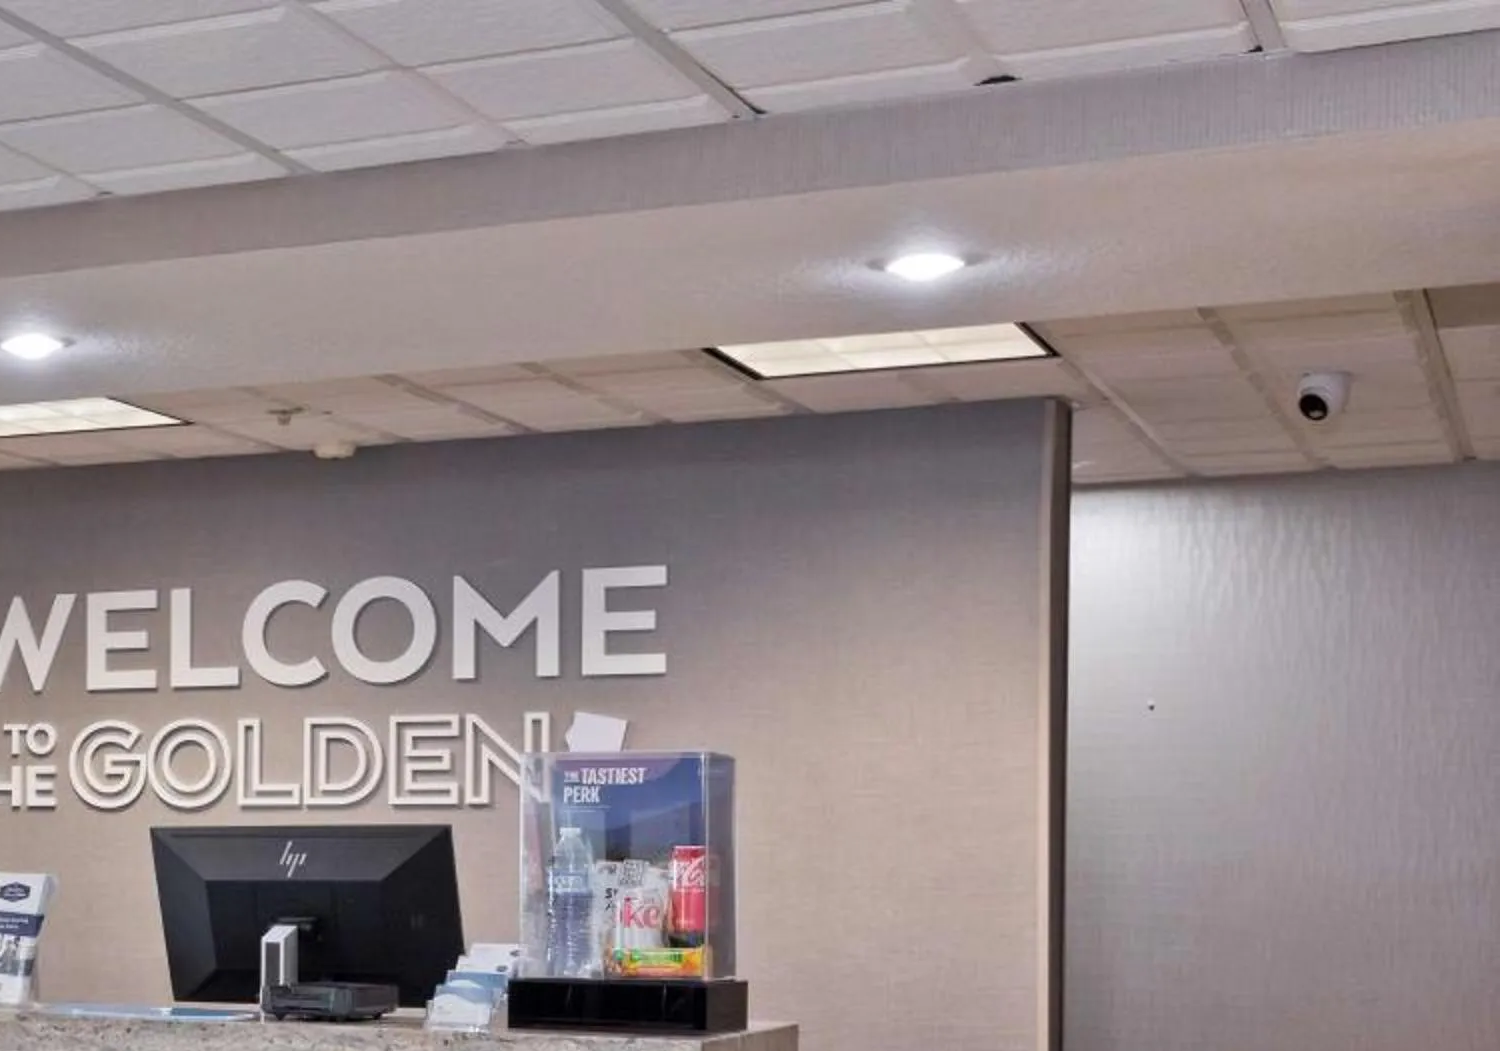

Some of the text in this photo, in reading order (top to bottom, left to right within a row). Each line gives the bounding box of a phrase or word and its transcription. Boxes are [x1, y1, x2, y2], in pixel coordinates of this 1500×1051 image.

[3, 722, 58, 757] TO
[68, 711, 552, 810] GOLDEN
[580, 767, 648, 786] TASTIEST
[563, 785, 601, 804] PERK
[279, 840, 308, 879] hp
